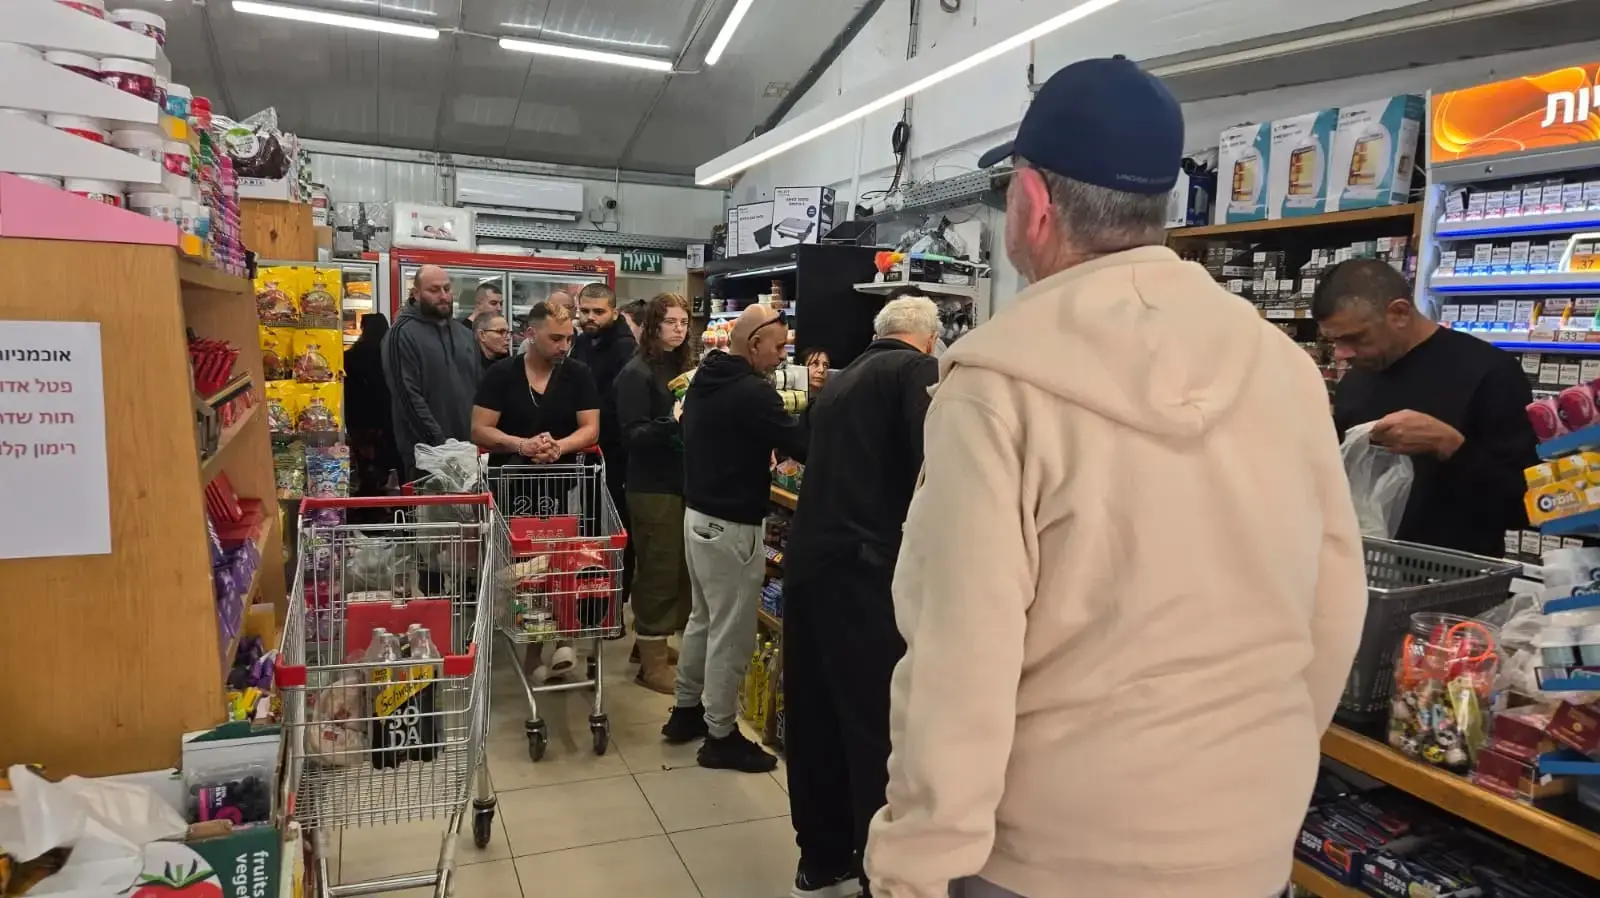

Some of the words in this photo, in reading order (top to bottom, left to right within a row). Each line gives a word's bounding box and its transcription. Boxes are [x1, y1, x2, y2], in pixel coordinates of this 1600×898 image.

[623, 252, 660, 272] יציאה
[34, 378, 72, 393] פטל
[39, 412, 74, 425] תות
[33, 442, 76, 459] רימון
[232, 853, 250, 898] vege
[253, 849, 269, 898] fruits
[1383, 878, 1406, 896] SOFT
